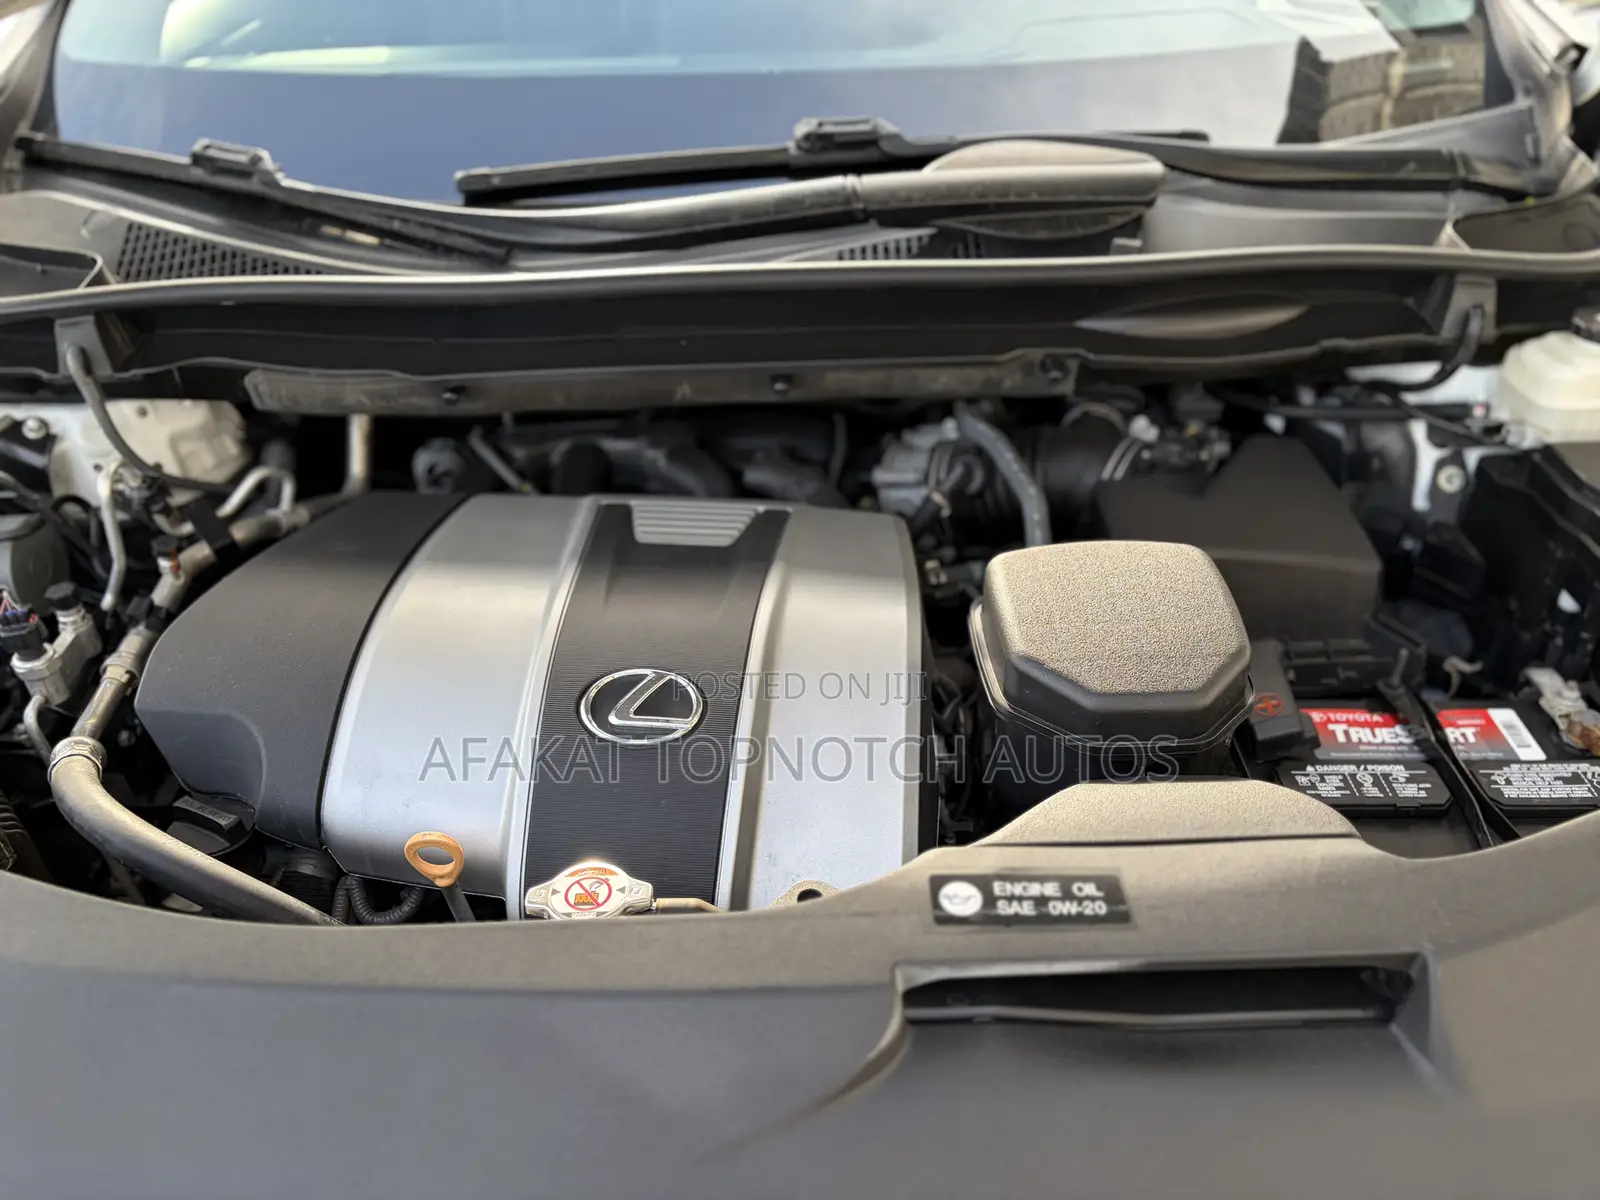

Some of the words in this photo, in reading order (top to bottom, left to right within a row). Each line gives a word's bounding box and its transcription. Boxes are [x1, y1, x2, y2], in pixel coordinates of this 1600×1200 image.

[1328, 712, 1384, 723] TOYOTA
[993, 881, 1062, 897] ENGINE
[1071, 882, 1104, 897] OIL
[996, 900, 1036, 916] SAE
[1048, 900, 1108, 916] 0W-20
